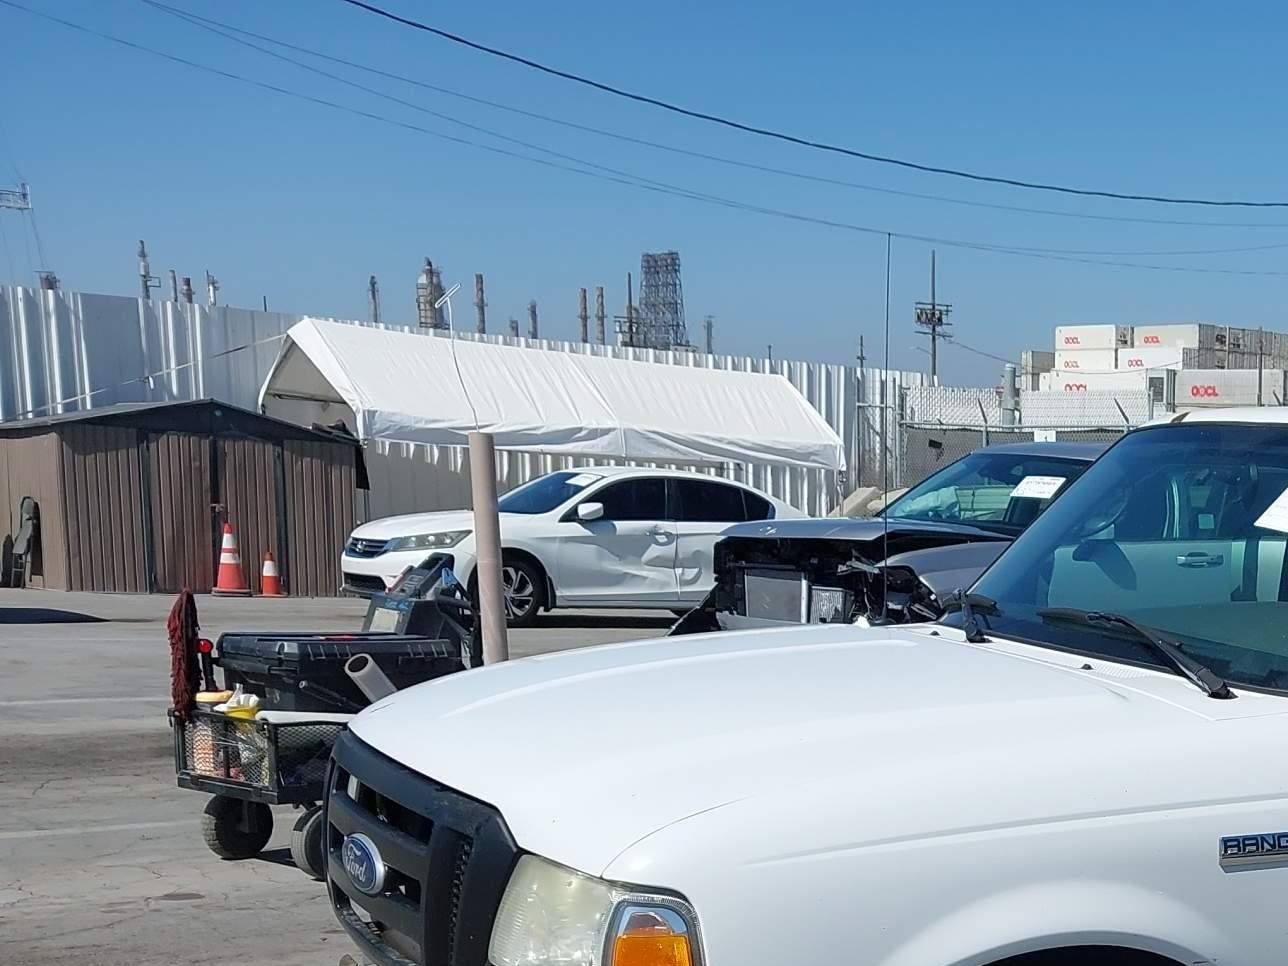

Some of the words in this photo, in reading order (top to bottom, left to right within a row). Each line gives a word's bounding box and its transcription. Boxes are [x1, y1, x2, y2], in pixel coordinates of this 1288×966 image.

[1127, 359, 1144, 367] OOCL
[1191, 386, 1219, 397] OOCL
[346, 843, 367, 882] Ford
